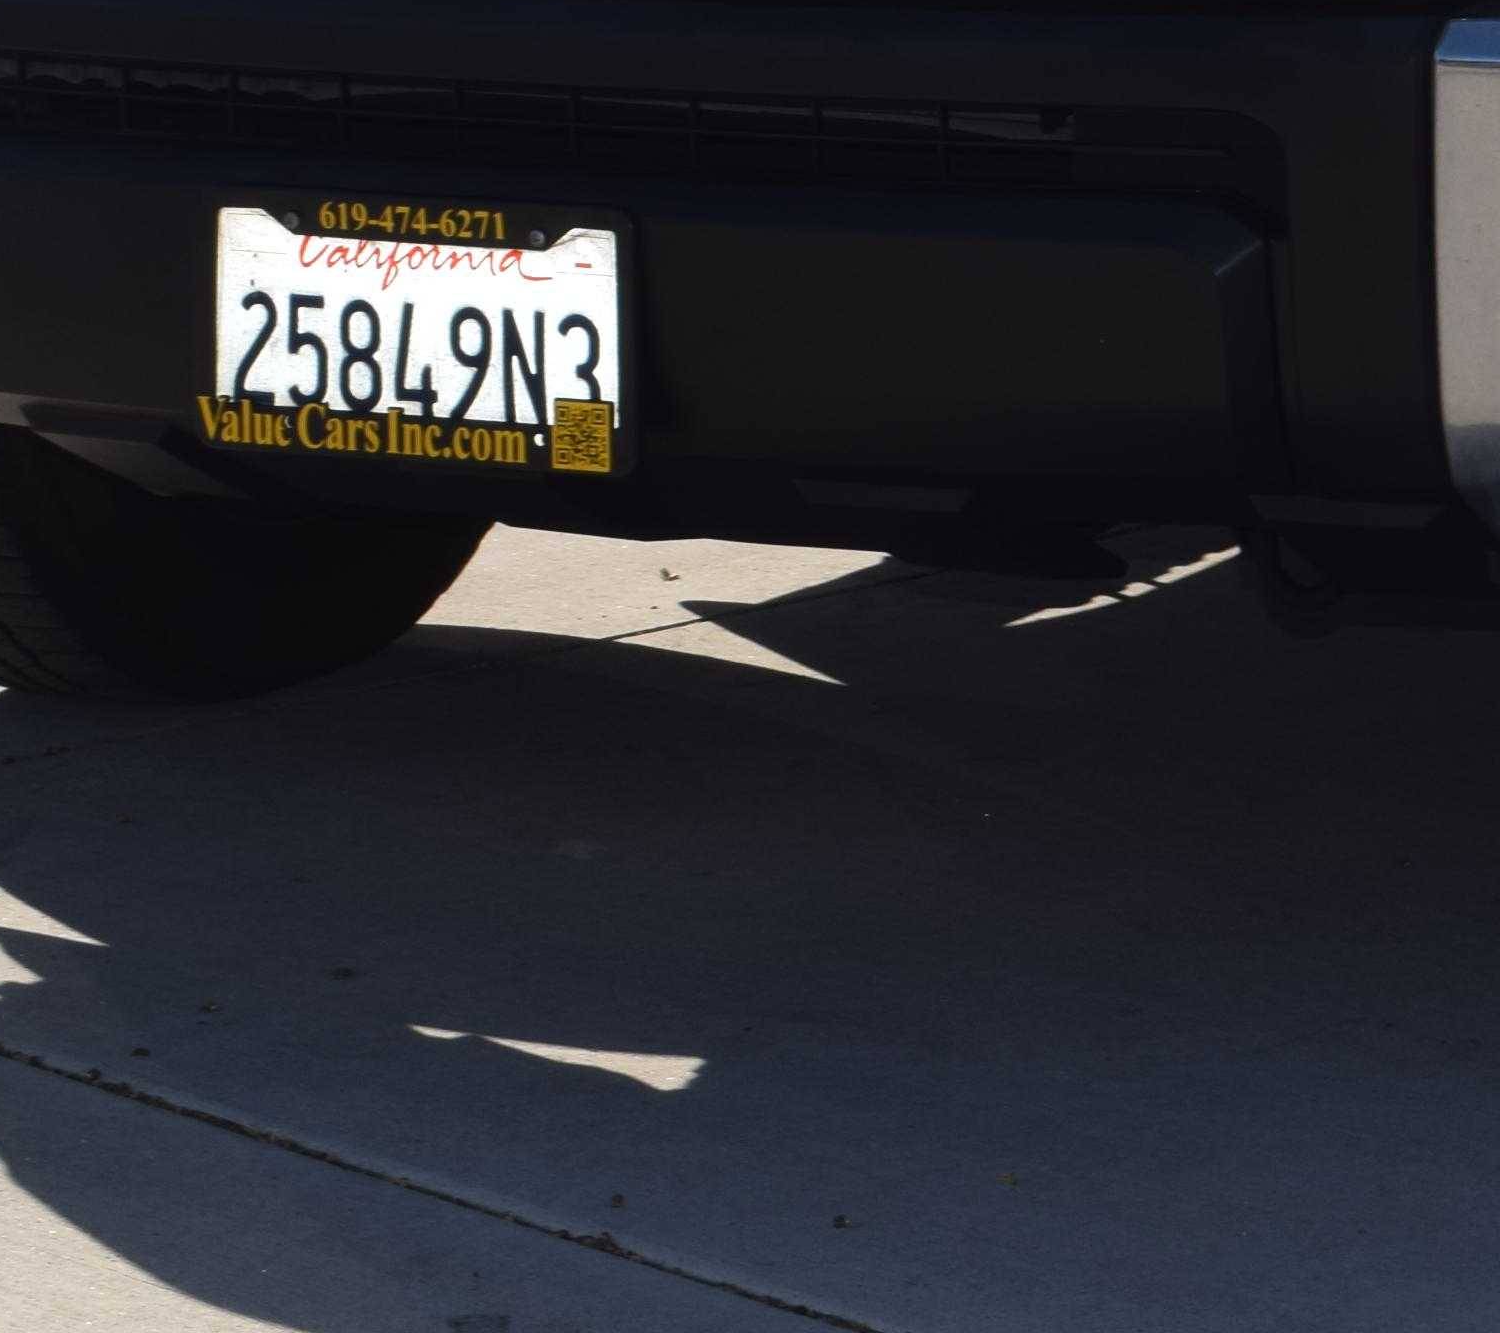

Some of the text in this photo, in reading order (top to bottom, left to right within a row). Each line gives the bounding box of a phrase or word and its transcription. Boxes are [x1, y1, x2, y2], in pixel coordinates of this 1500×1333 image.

[317, 201, 507, 240] 619-474-6271
[299, 233, 554, 290] California
[233, 290, 602, 427] 25849N3
[197, 395, 528, 465] Value Cars Inc.com
